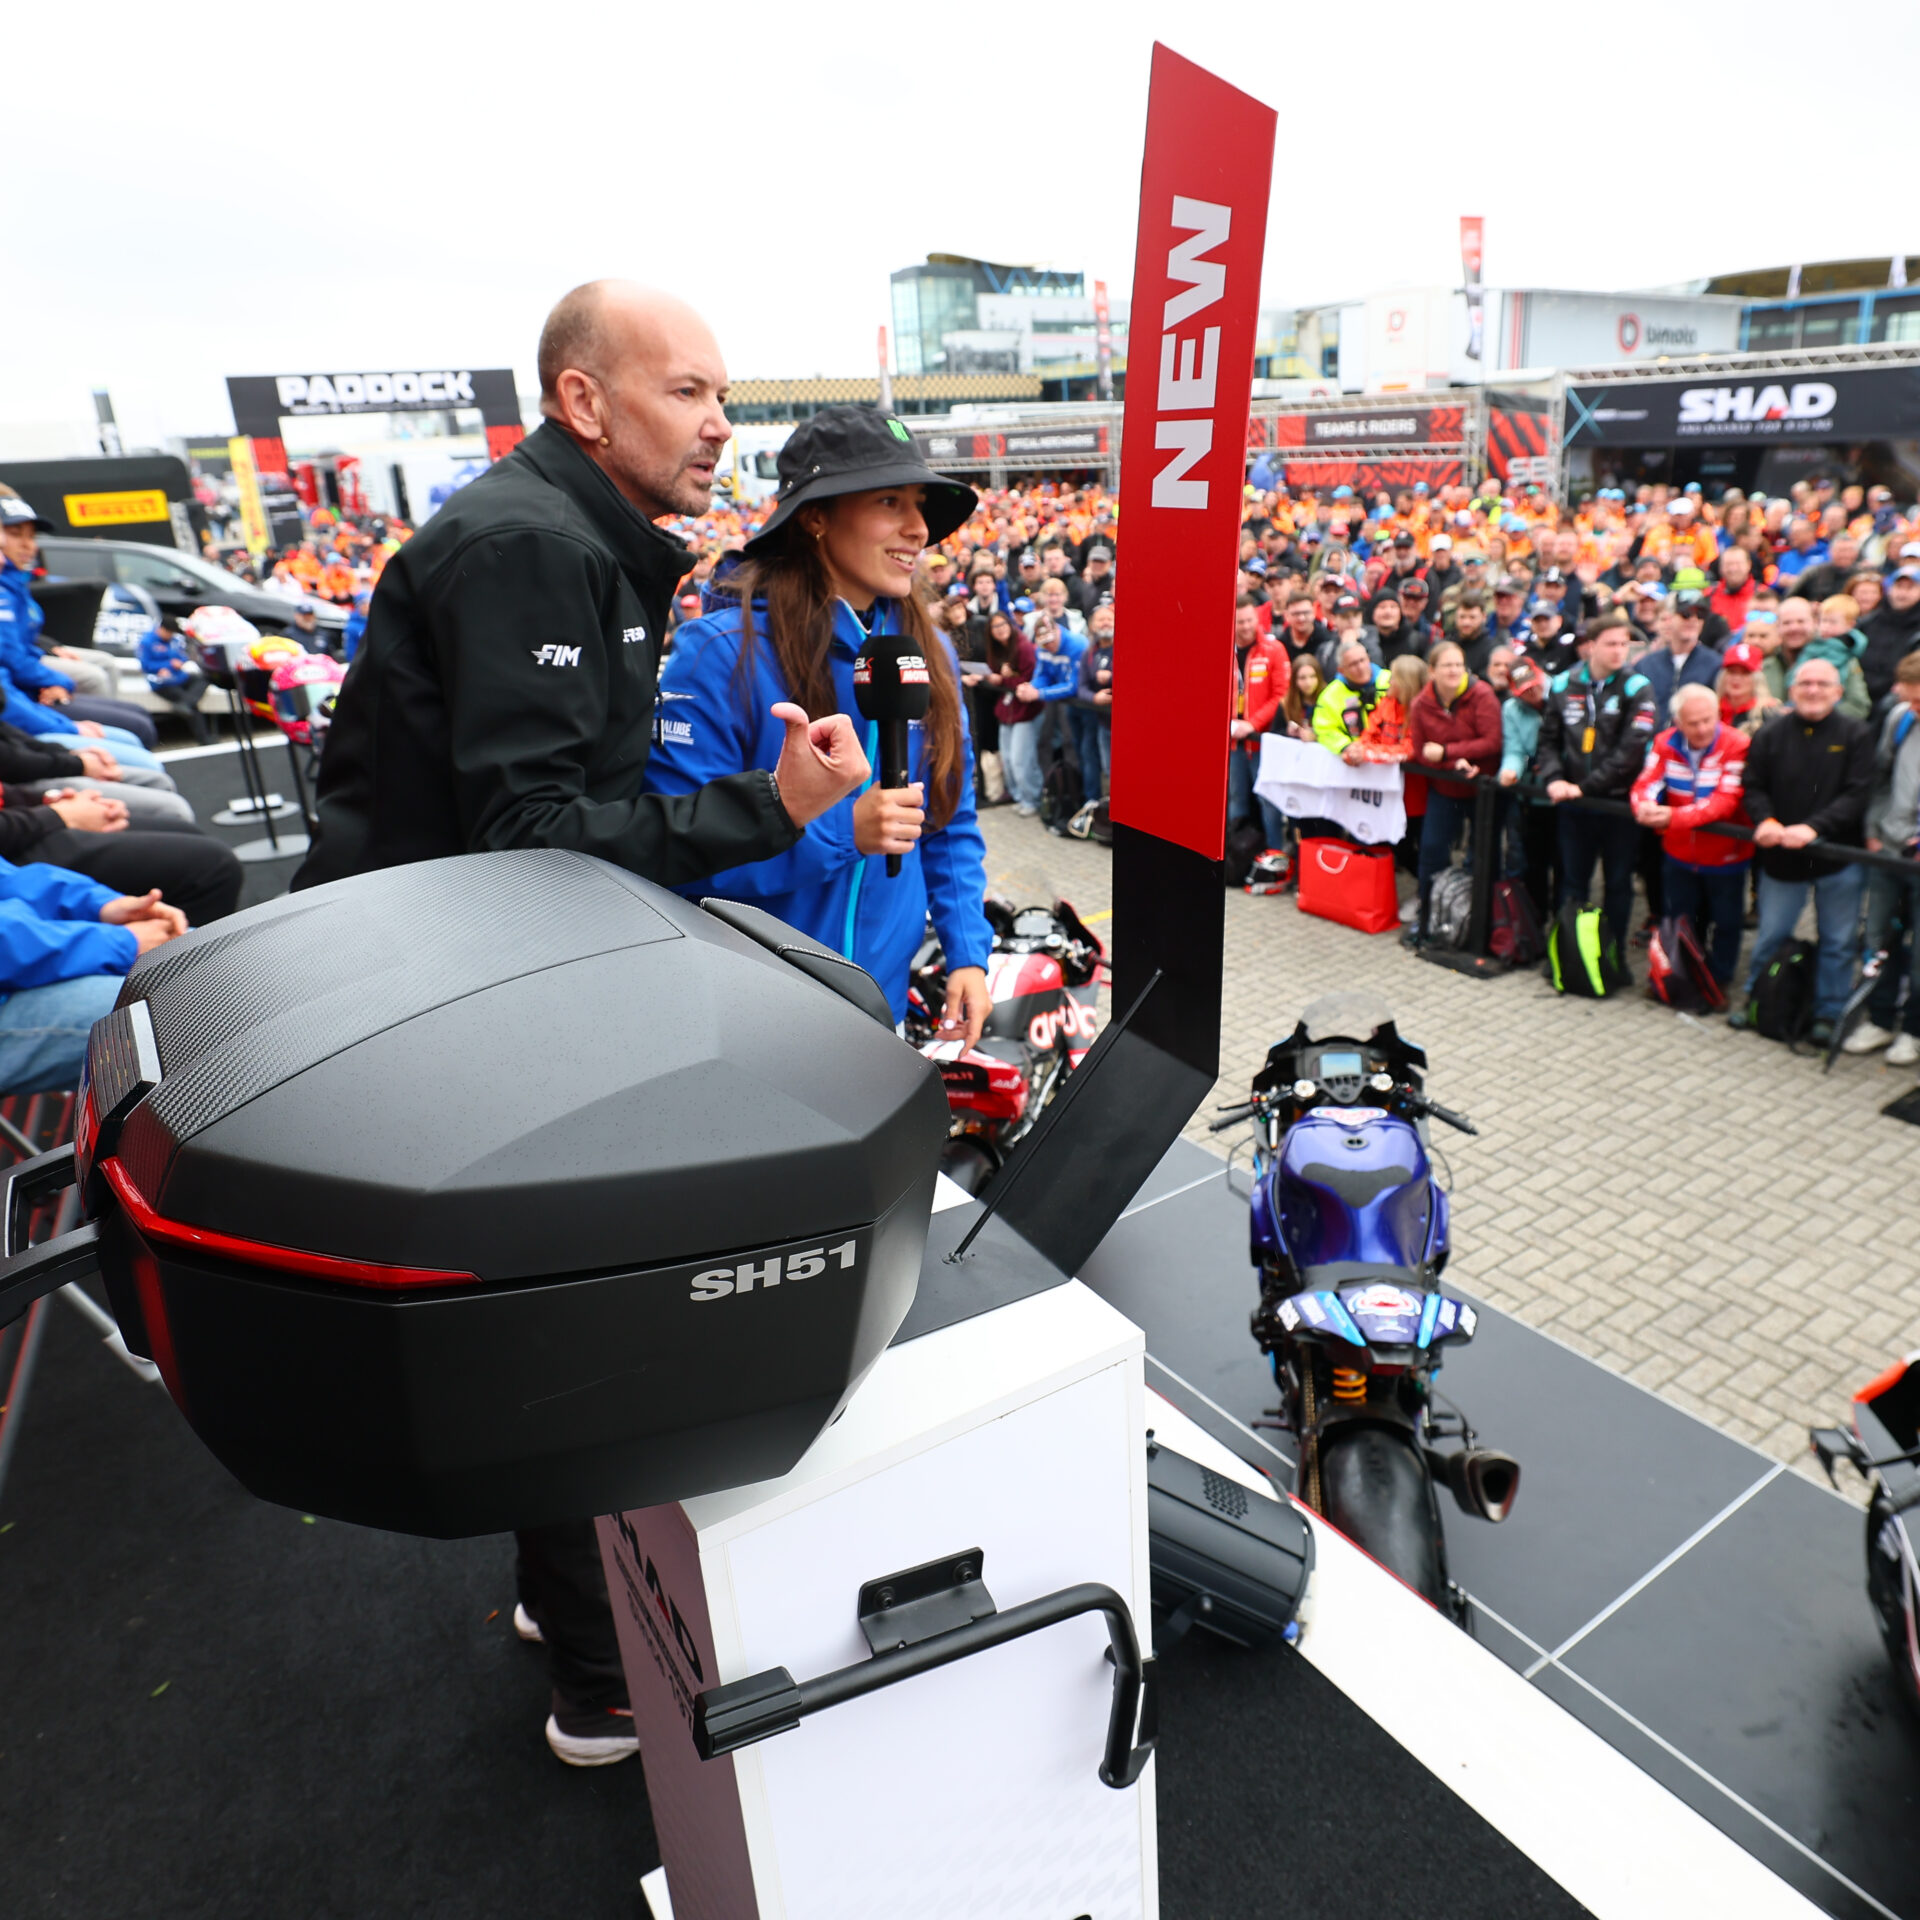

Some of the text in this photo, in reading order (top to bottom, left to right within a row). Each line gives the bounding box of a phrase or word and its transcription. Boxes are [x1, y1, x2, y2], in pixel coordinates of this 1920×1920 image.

[1151, 195, 1232, 509] NEW
[276, 371, 475, 407] PADDOCK
[1678, 382, 1837, 423] SHAD
[1315, 422, 1356, 438] TEAMS
[1369, 418, 1417, 435] RIDERS
[531, 644, 582, 667] FIM
[854, 657, 874, 670] BK
[690, 1240, 856, 1301] SH51
